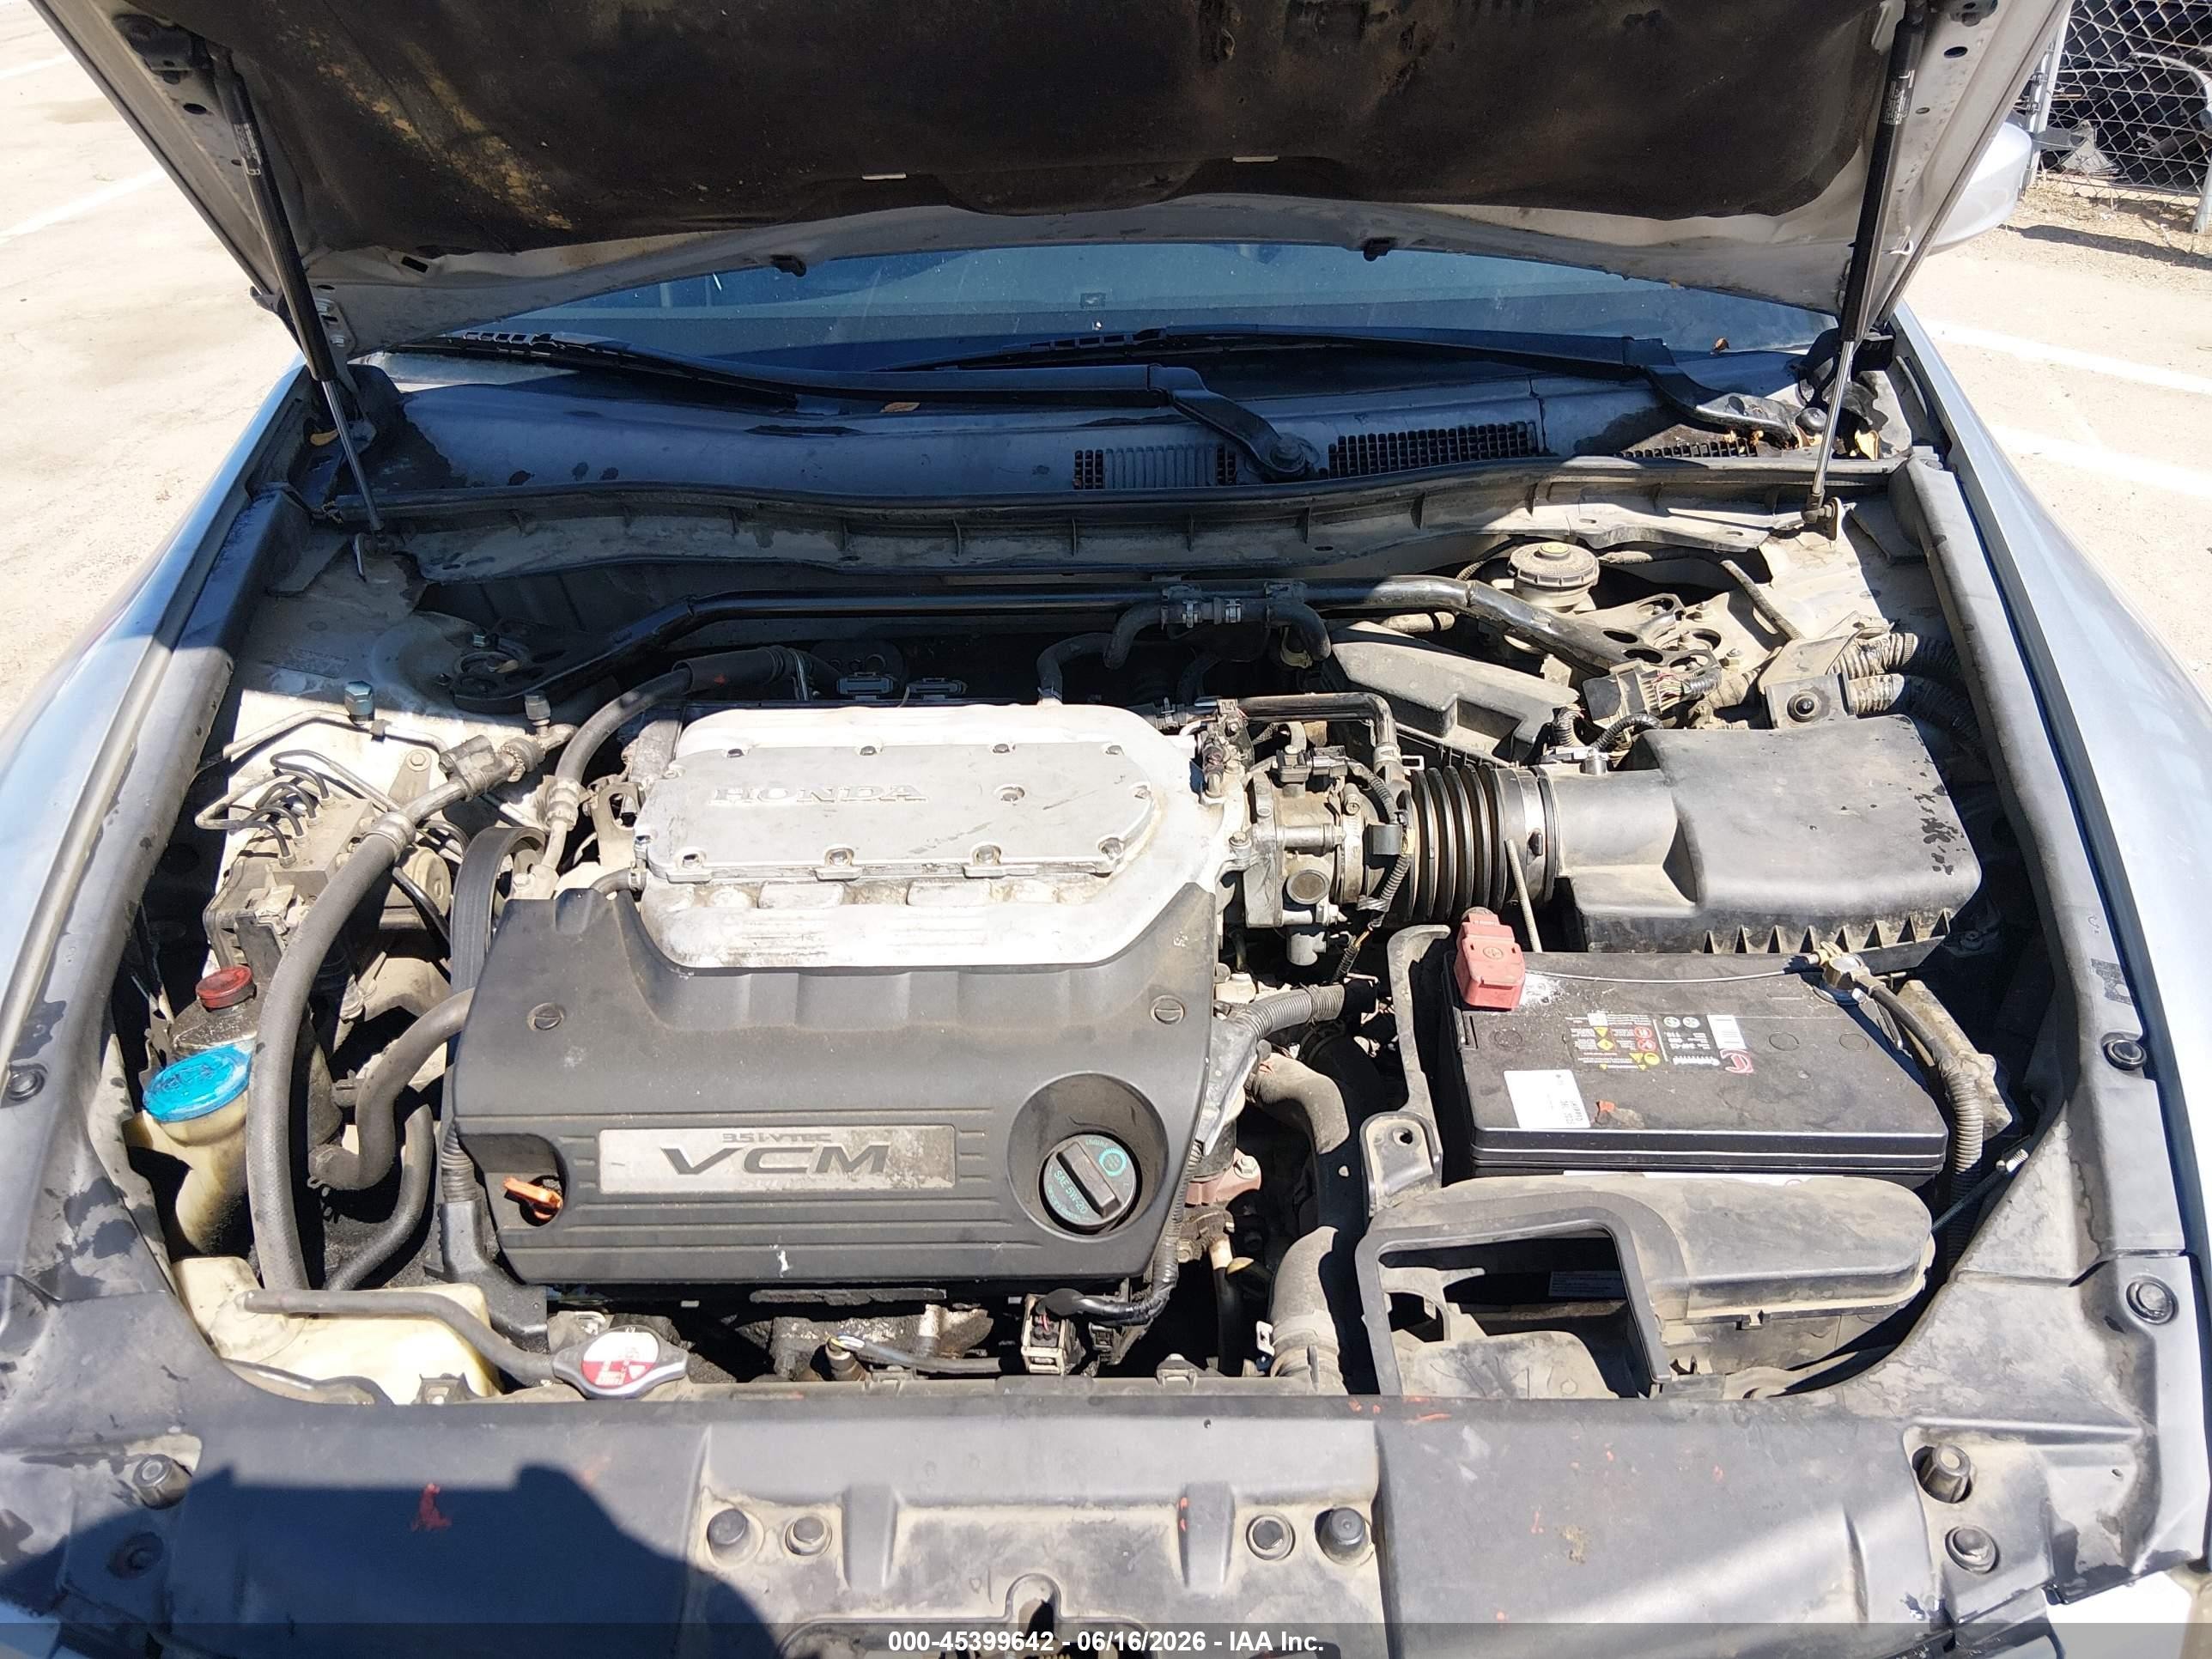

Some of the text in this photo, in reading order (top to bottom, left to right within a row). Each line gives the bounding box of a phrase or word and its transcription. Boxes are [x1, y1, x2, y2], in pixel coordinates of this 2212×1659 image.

[710, 784, 927, 805] HONDA
[660, 1144, 890, 1176] VCM
[1054, 1170, 1070, 1188] SAE
[1065, 1186, 1089, 1215] 5W-20
